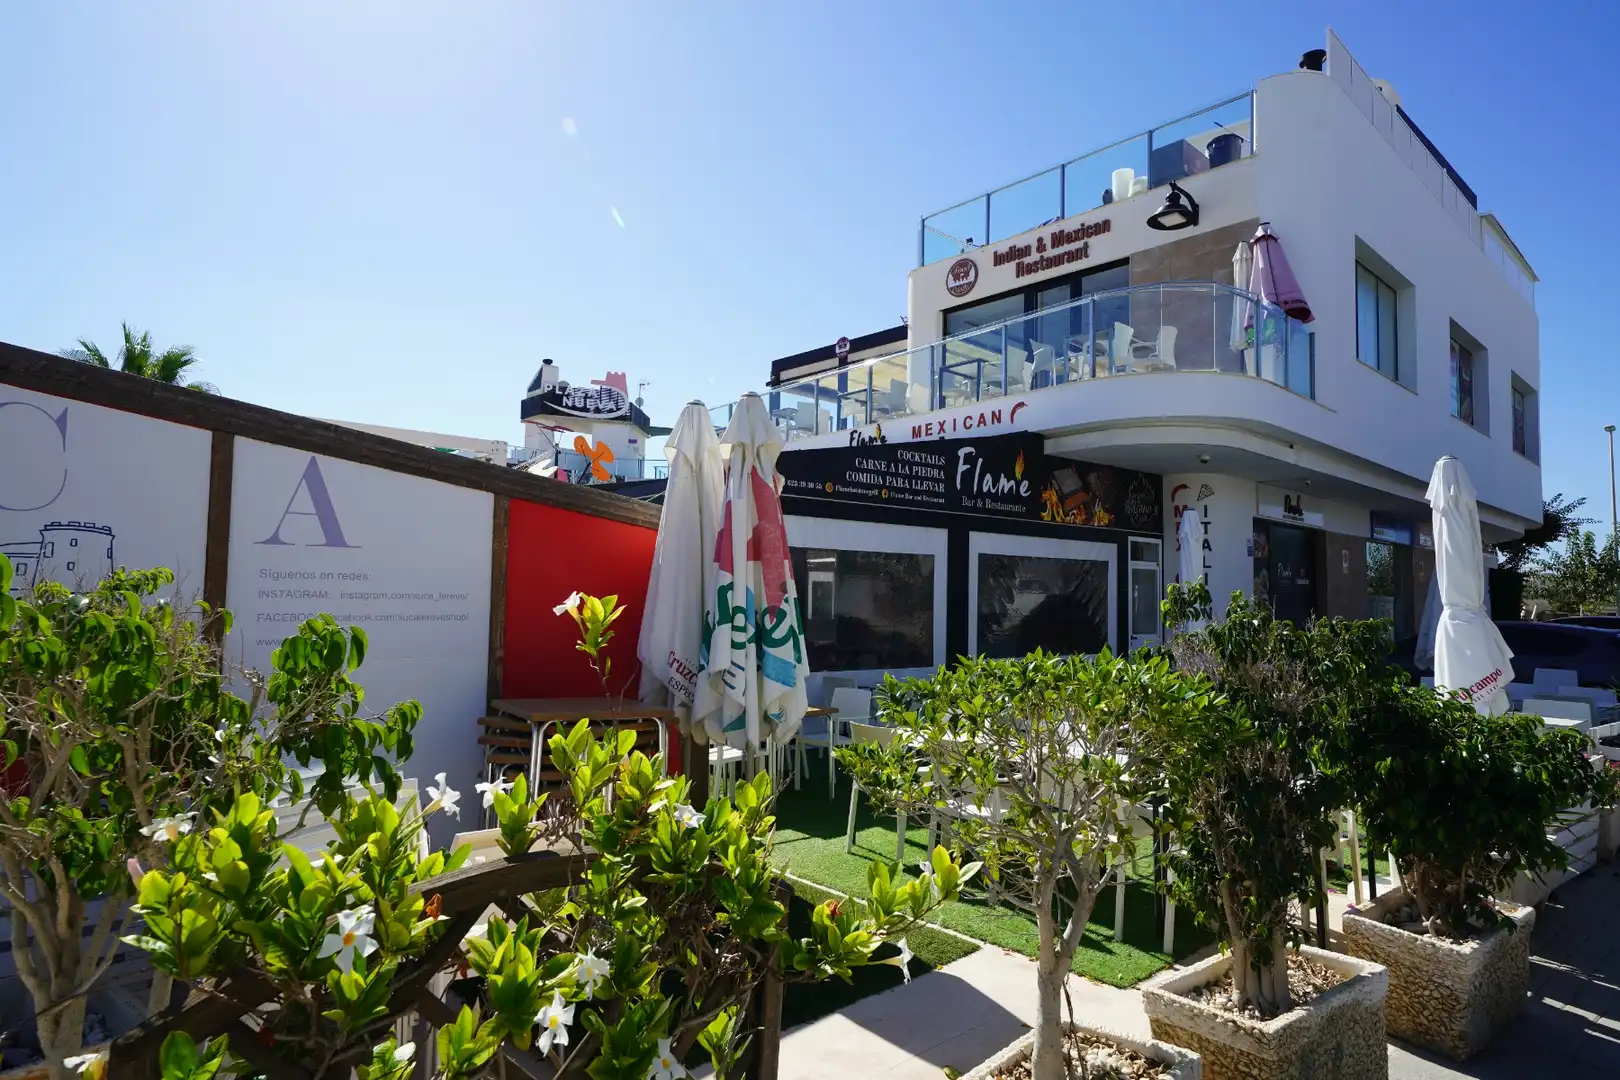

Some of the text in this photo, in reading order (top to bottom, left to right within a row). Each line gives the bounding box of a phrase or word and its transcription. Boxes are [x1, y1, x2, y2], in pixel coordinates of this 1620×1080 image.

[993, 219, 1111, 267] Indian & Mexican
[1015, 242, 1089, 278] Restaurant
[544, 384, 599, 398] PLAZA
[563, 396, 617, 411] NUEVA
[912, 409, 1002, 439] MEXICAN
[855, 457, 945, 480] CARNE A LA PIEDRA
[897, 449, 946, 466] COCKTAILS
[846, 471, 945, 493] COMIDA PARA LLEVAR
[956, 446, 1032, 497] Flame
[962, 496, 1026, 513] Bar & Restaurante
[320, 572, 334, 580] en
[337, 571, 372, 581] redes:
[257, 589, 333, 600] INSTAGRAM:
[667, 650, 698, 687] Cruzc
[668, 676, 695, 700] ESPEC
